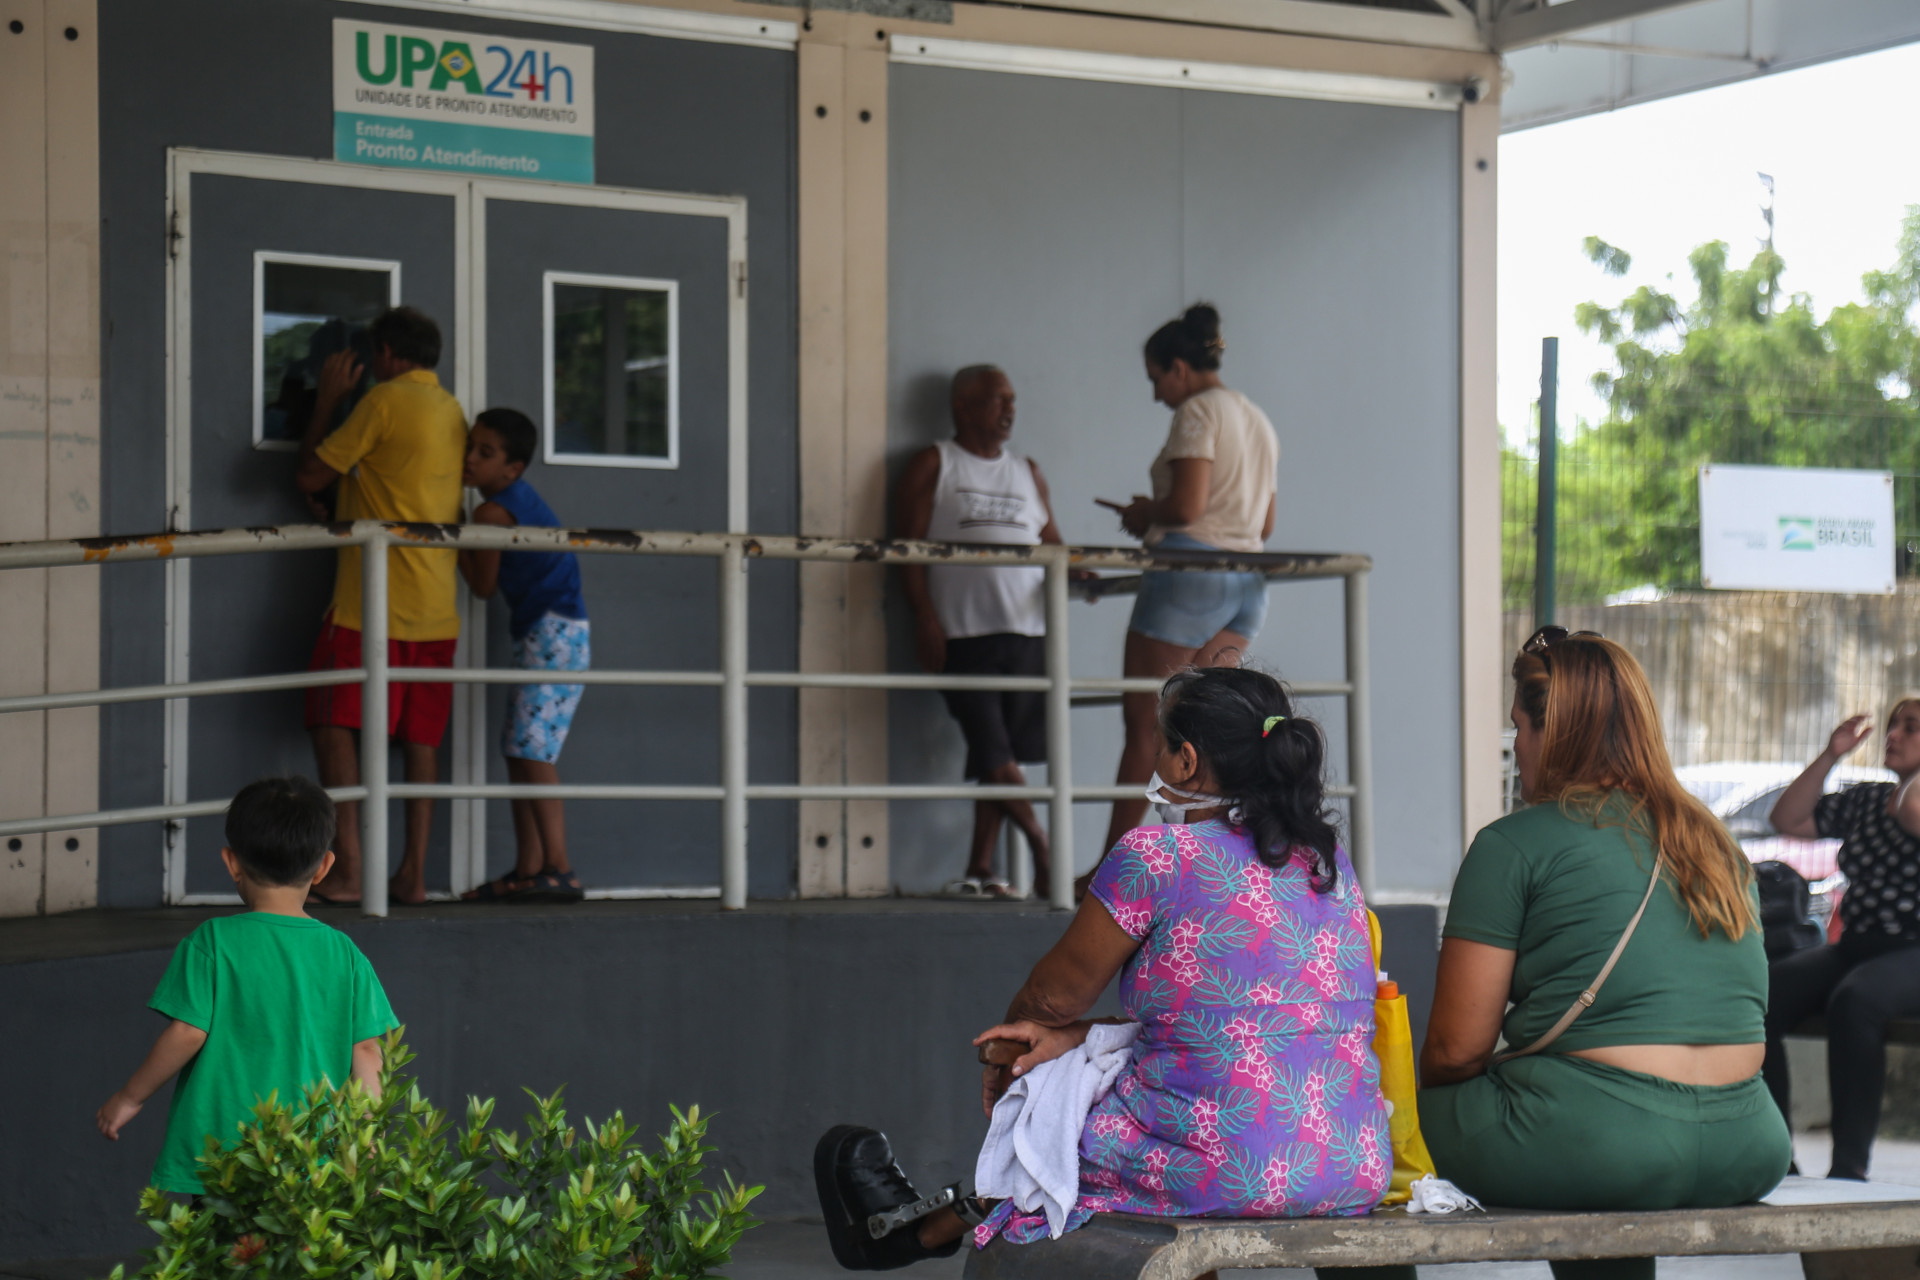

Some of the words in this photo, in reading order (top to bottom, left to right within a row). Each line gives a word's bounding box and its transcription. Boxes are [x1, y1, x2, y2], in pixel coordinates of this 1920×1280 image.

[355, 89, 411, 108] UNIDADE
[415, 96, 431, 109] DE
[435, 98, 486, 115] PRONTO
[489, 106, 577, 124] ATENDIMENTO
[355, 121, 413, 140] Entrada
[355, 139, 417, 161] Pronto
[421, 145, 540, 173] Atendimento
[1817, 528, 1875, 548] BRASIL
